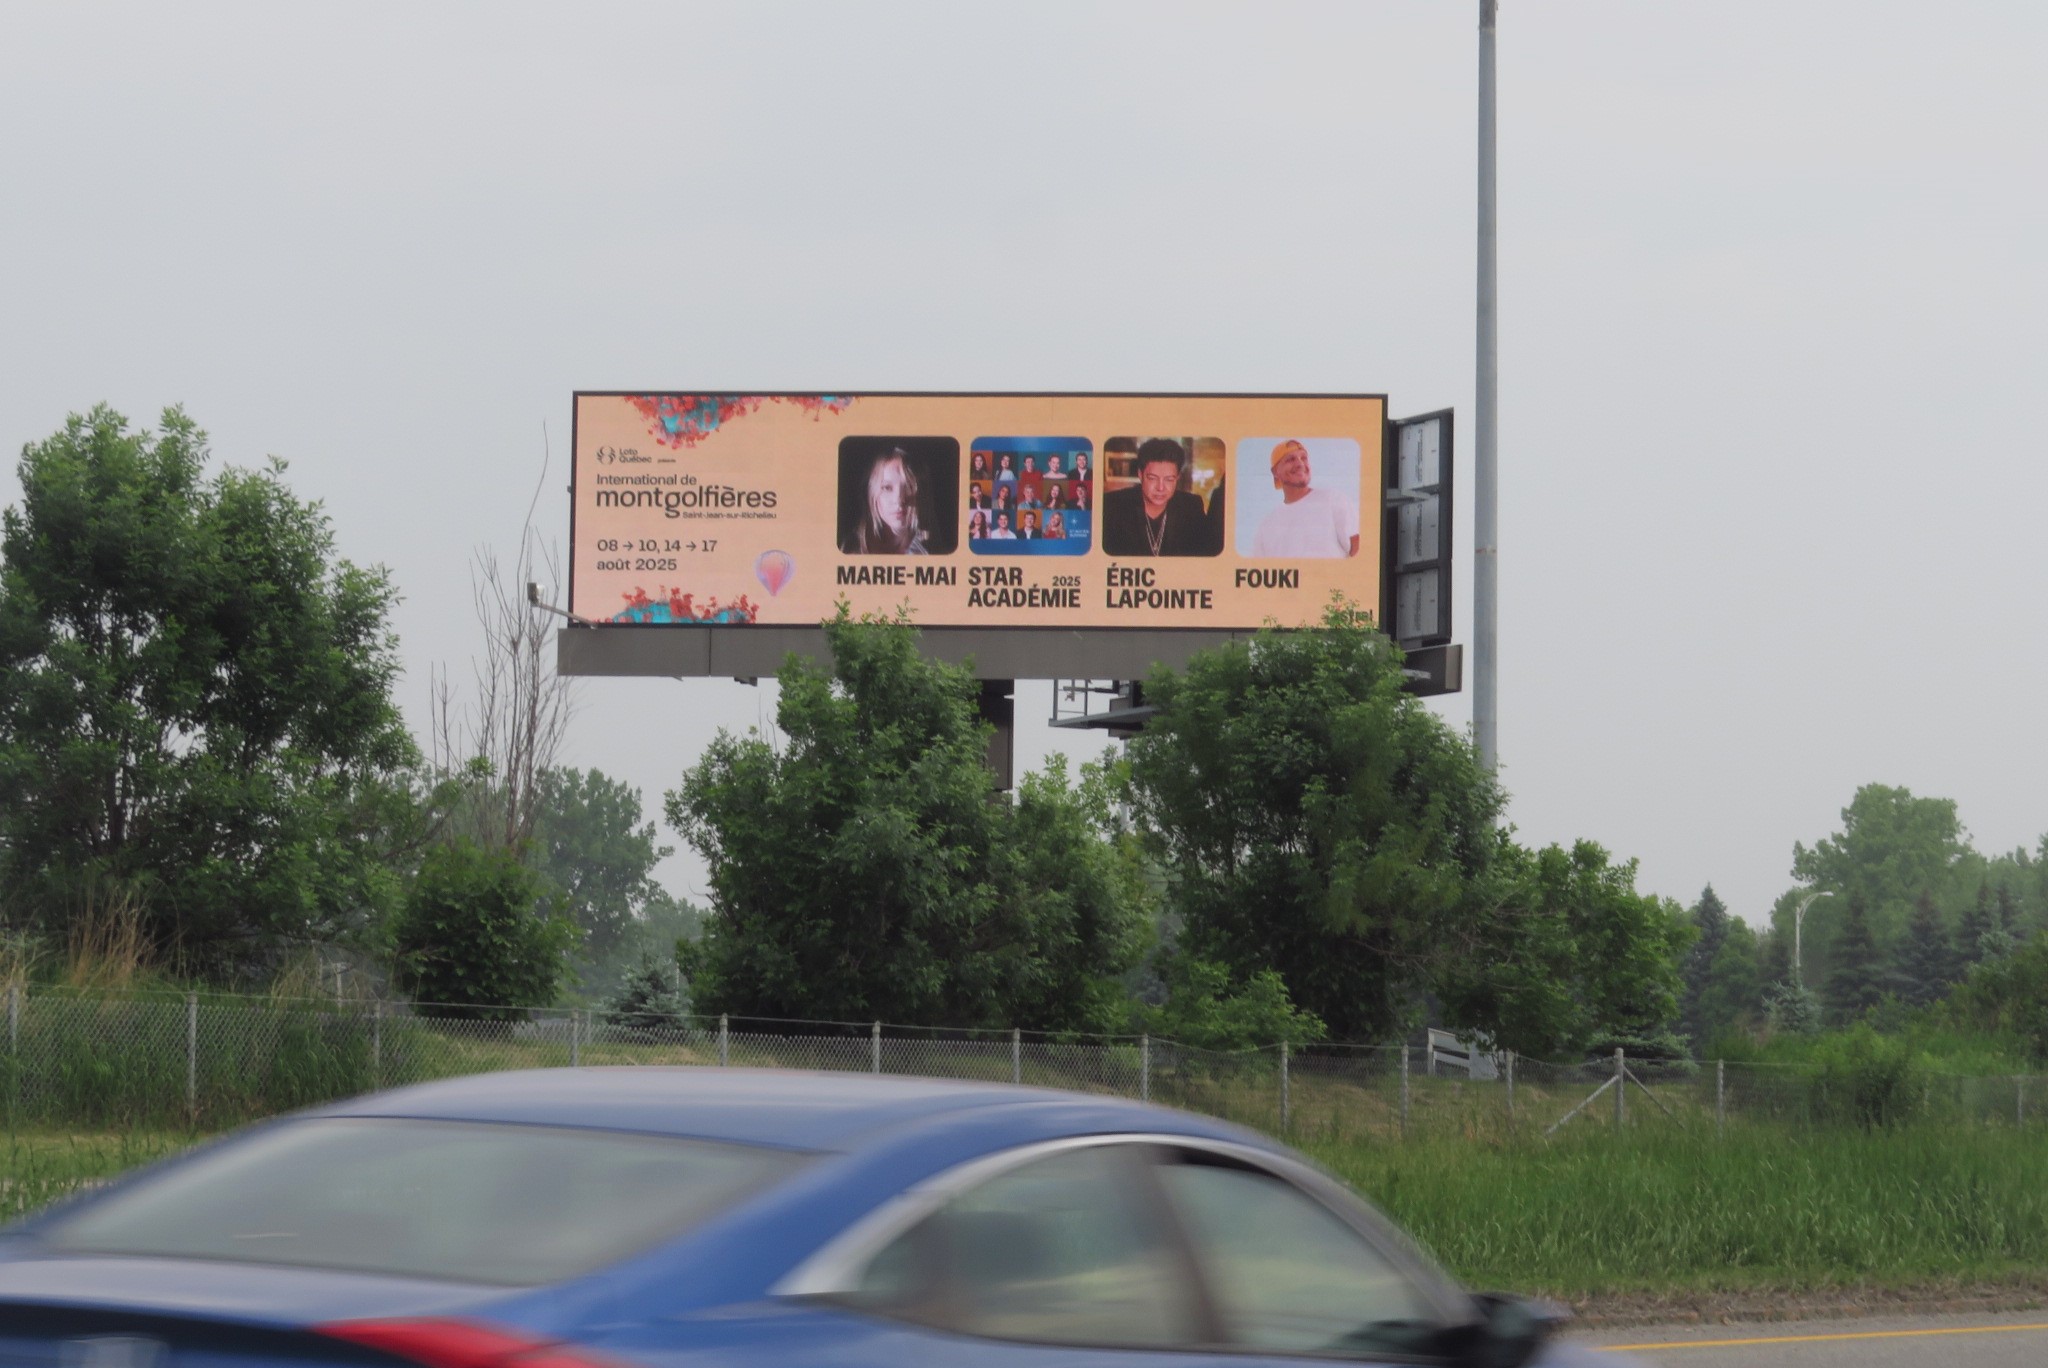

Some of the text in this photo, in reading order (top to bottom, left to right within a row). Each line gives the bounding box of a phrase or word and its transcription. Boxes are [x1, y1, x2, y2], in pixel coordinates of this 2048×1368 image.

[597, 474, 697, 486] International de
[596, 485, 777, 519] montgolfières
[597, 539, 718, 554] 08 10, 14 17
[597, 558, 677, 571] août 2025
[1106, 562, 1155, 587] ÉRIC
[837, 565, 957, 586] MARIE-MAI
[968, 567, 1081, 587] STAR 2025
[1235, 568, 1299, 588] FOUKI
[968, 583, 1081, 608] ACADÉMIE
[1106, 589, 1213, 609] LAPOINTE
